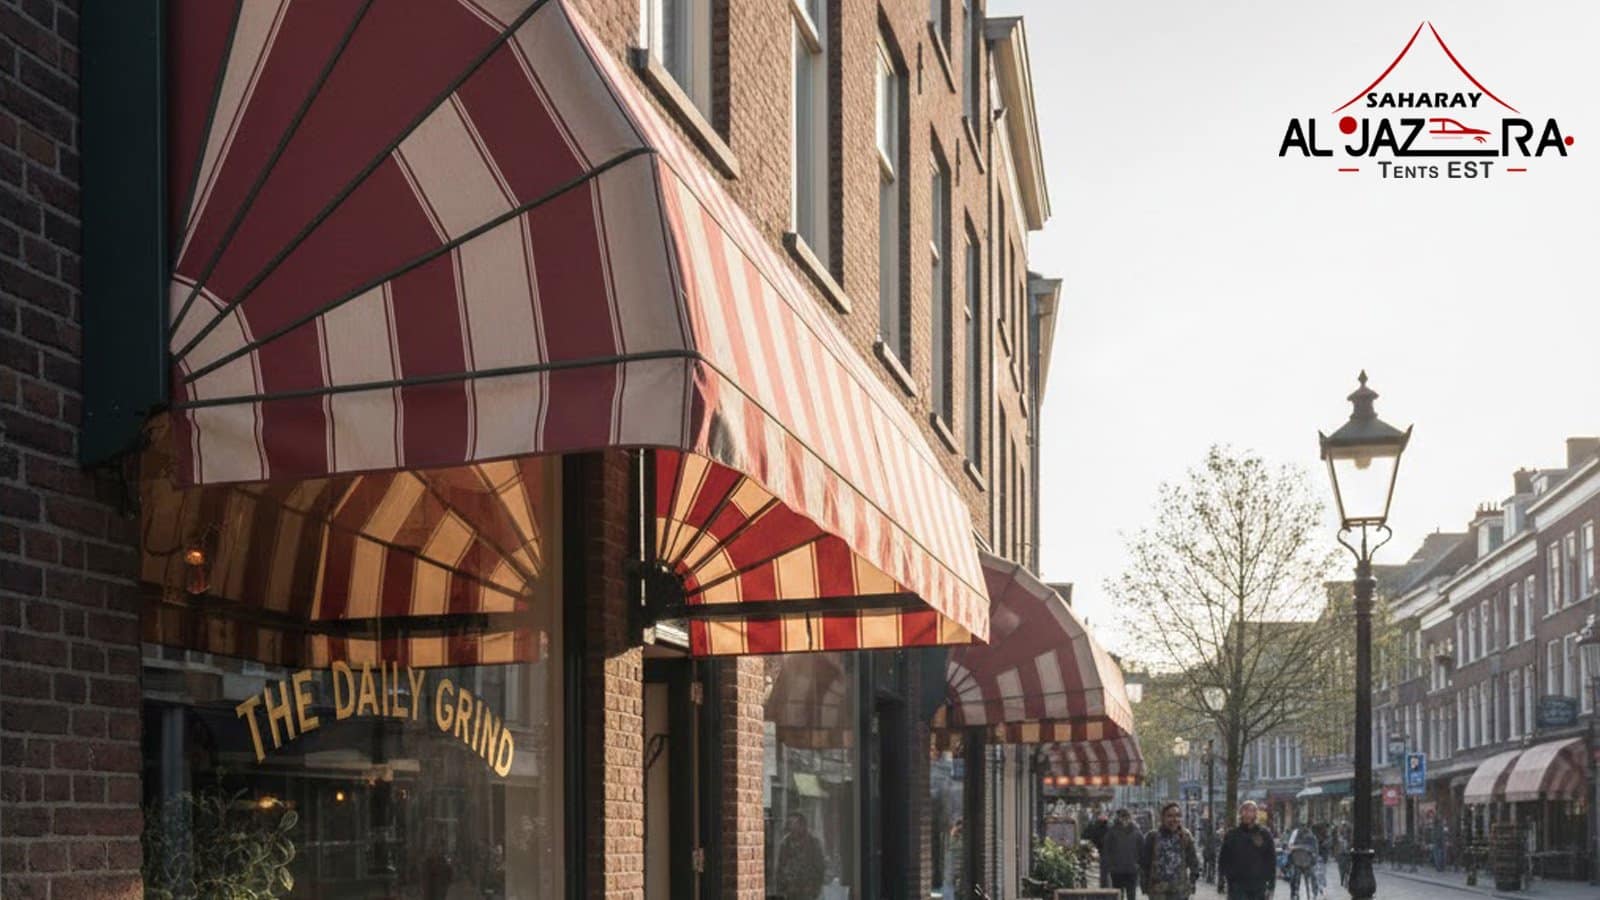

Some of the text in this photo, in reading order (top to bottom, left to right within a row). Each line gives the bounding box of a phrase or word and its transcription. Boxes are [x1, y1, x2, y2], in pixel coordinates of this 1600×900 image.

[236, 660, 515, 777] THE DAILY GRIND
